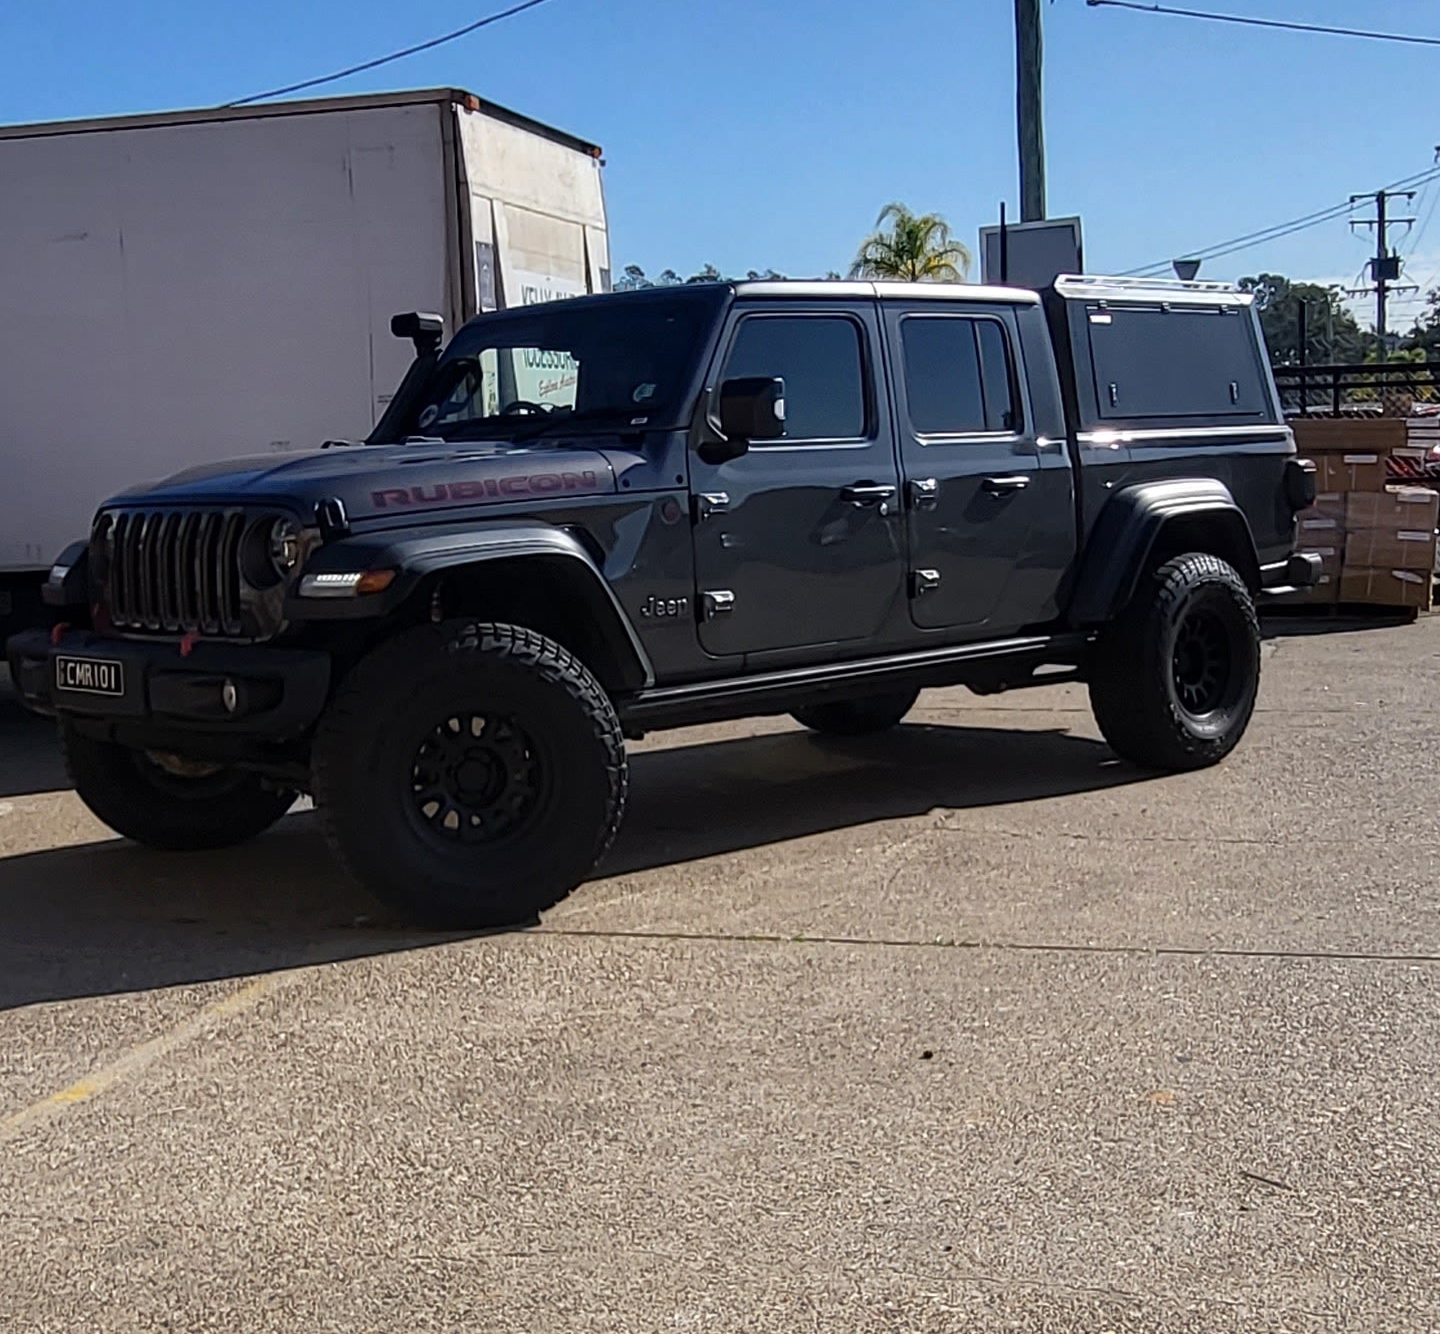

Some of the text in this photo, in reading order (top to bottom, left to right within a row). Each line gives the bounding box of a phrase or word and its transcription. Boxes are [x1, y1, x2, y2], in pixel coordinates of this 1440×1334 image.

[370, 470, 598, 510] RUBICON
[641, 596, 688, 618] Jeep
[66, 662, 115, 690] CMR101
